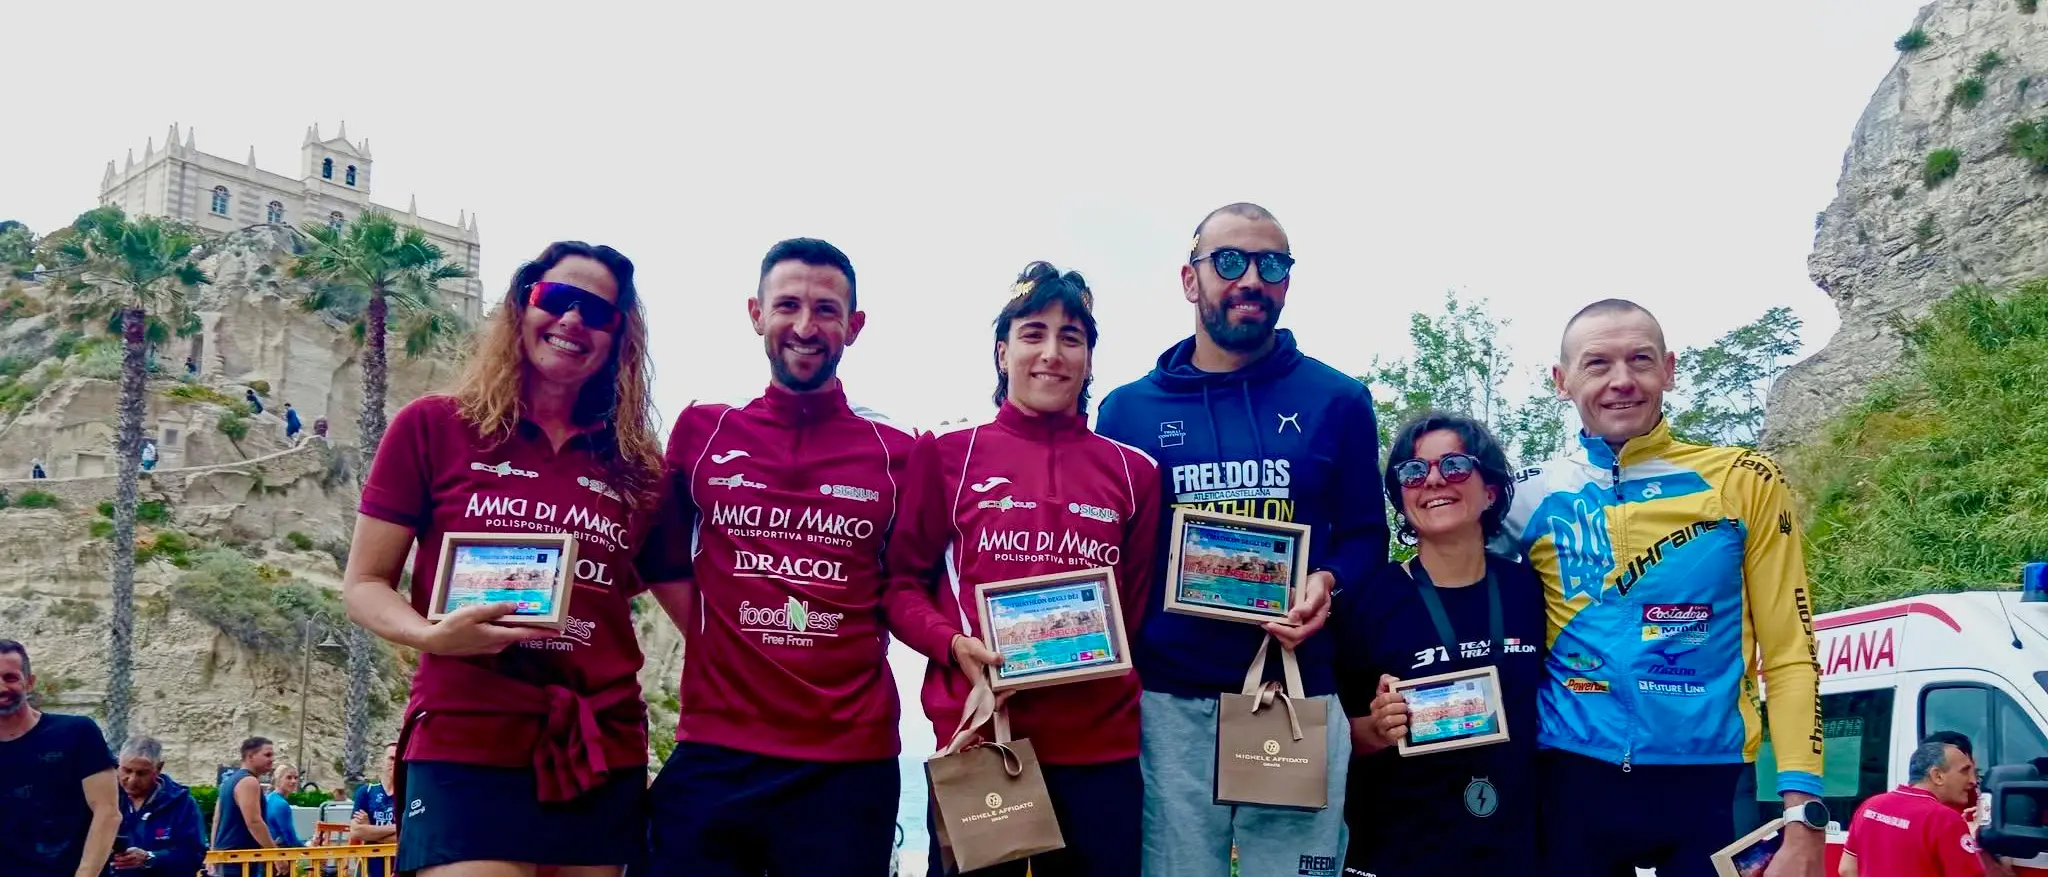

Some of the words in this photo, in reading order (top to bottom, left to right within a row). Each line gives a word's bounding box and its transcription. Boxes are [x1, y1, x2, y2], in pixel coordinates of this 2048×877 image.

[1193, 491, 1225, 501] ATLETICA
[1225, 488, 1271, 499] CASTELLANA
[534, 501, 557, 520] DI
[769, 507, 792, 529] DI
[796, 506, 874, 540] MARCO
[573, 531, 616, 553] BITONTO
[727, 528, 802, 541] POLISPORTIVA
[807, 535, 853, 548] BITONTO
[1036, 532, 1054, 552] DI
[1058, 528, 1120, 566] MARCO
[734, 550, 848, 582] IDRACOL
[994, 553, 1064, 566] POLISPORTIVA
[545, 638, 574, 652] From
[762, 633, 785, 645] Free
[786, 634, 814, 647] From
[1648, 680, 1683, 693] FUTURE
[1684, 683, 1706, 694] LINE
[1235, 752, 1271, 762] MICHELE
[1272, 756, 1309, 765] AFFIDATO
[961, 810, 998, 824] MICHELE
[998, 801, 1034, 815] AFFIDATO
